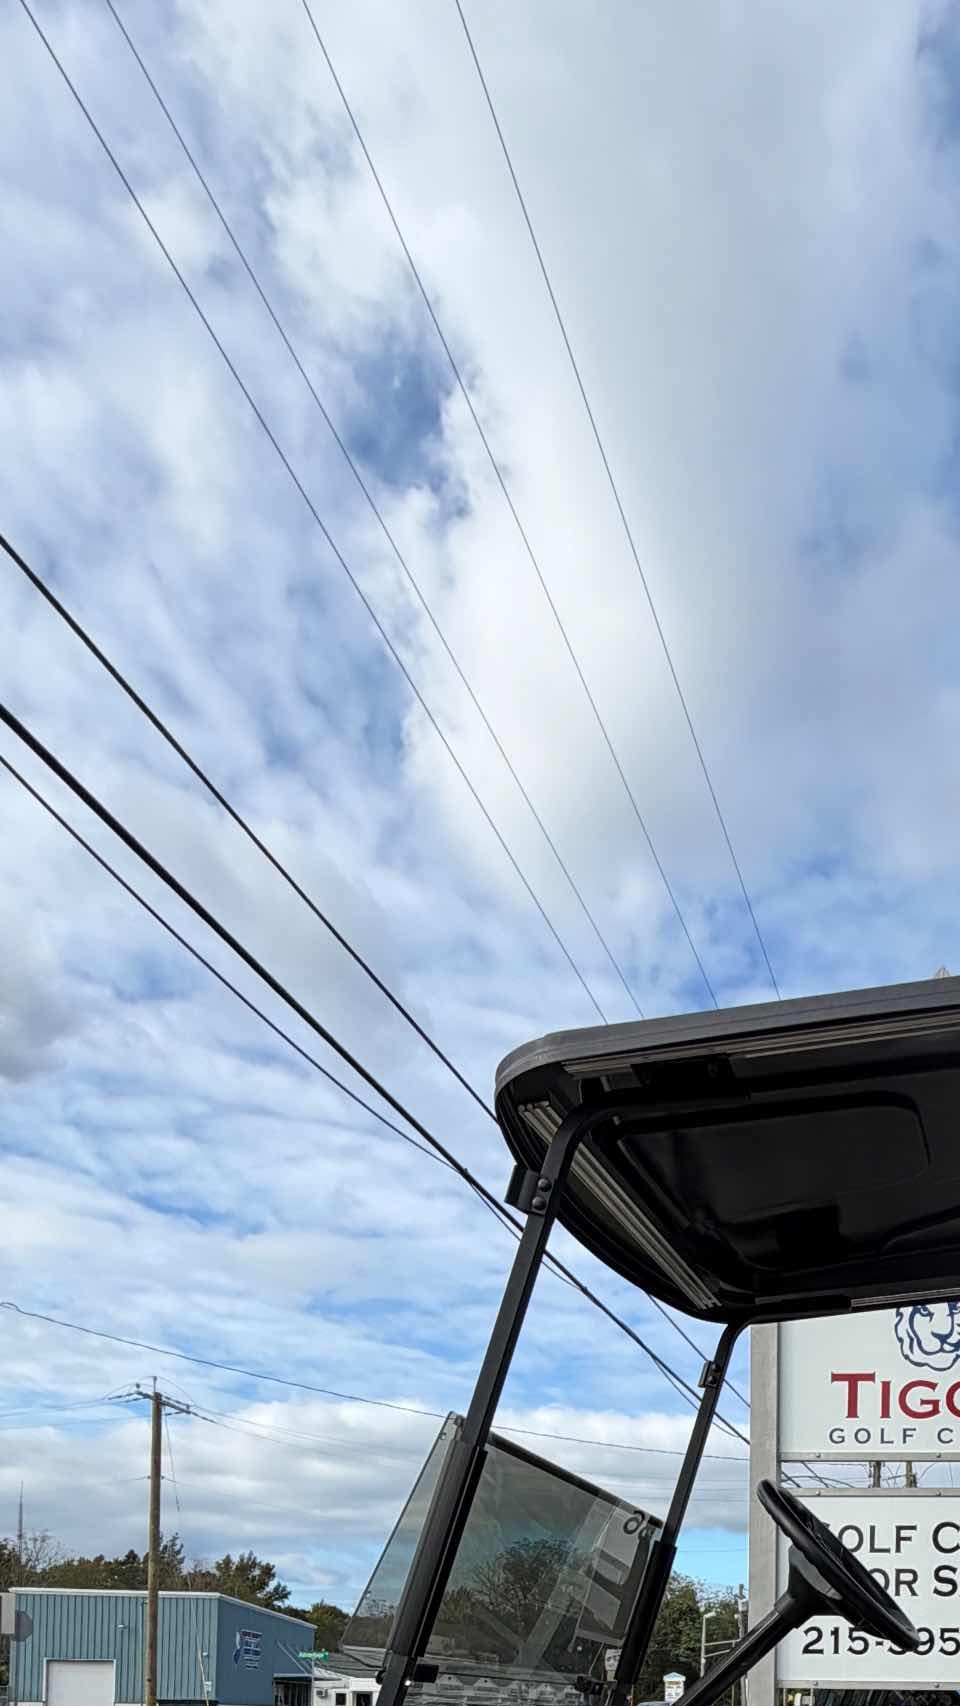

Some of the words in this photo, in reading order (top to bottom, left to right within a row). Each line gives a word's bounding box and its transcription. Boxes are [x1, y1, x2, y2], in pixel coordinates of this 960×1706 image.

[828, 1427, 917, 1445] GOLF
[824, 1522, 917, 1554] OLF
[867, 1567, 919, 1597] OR
